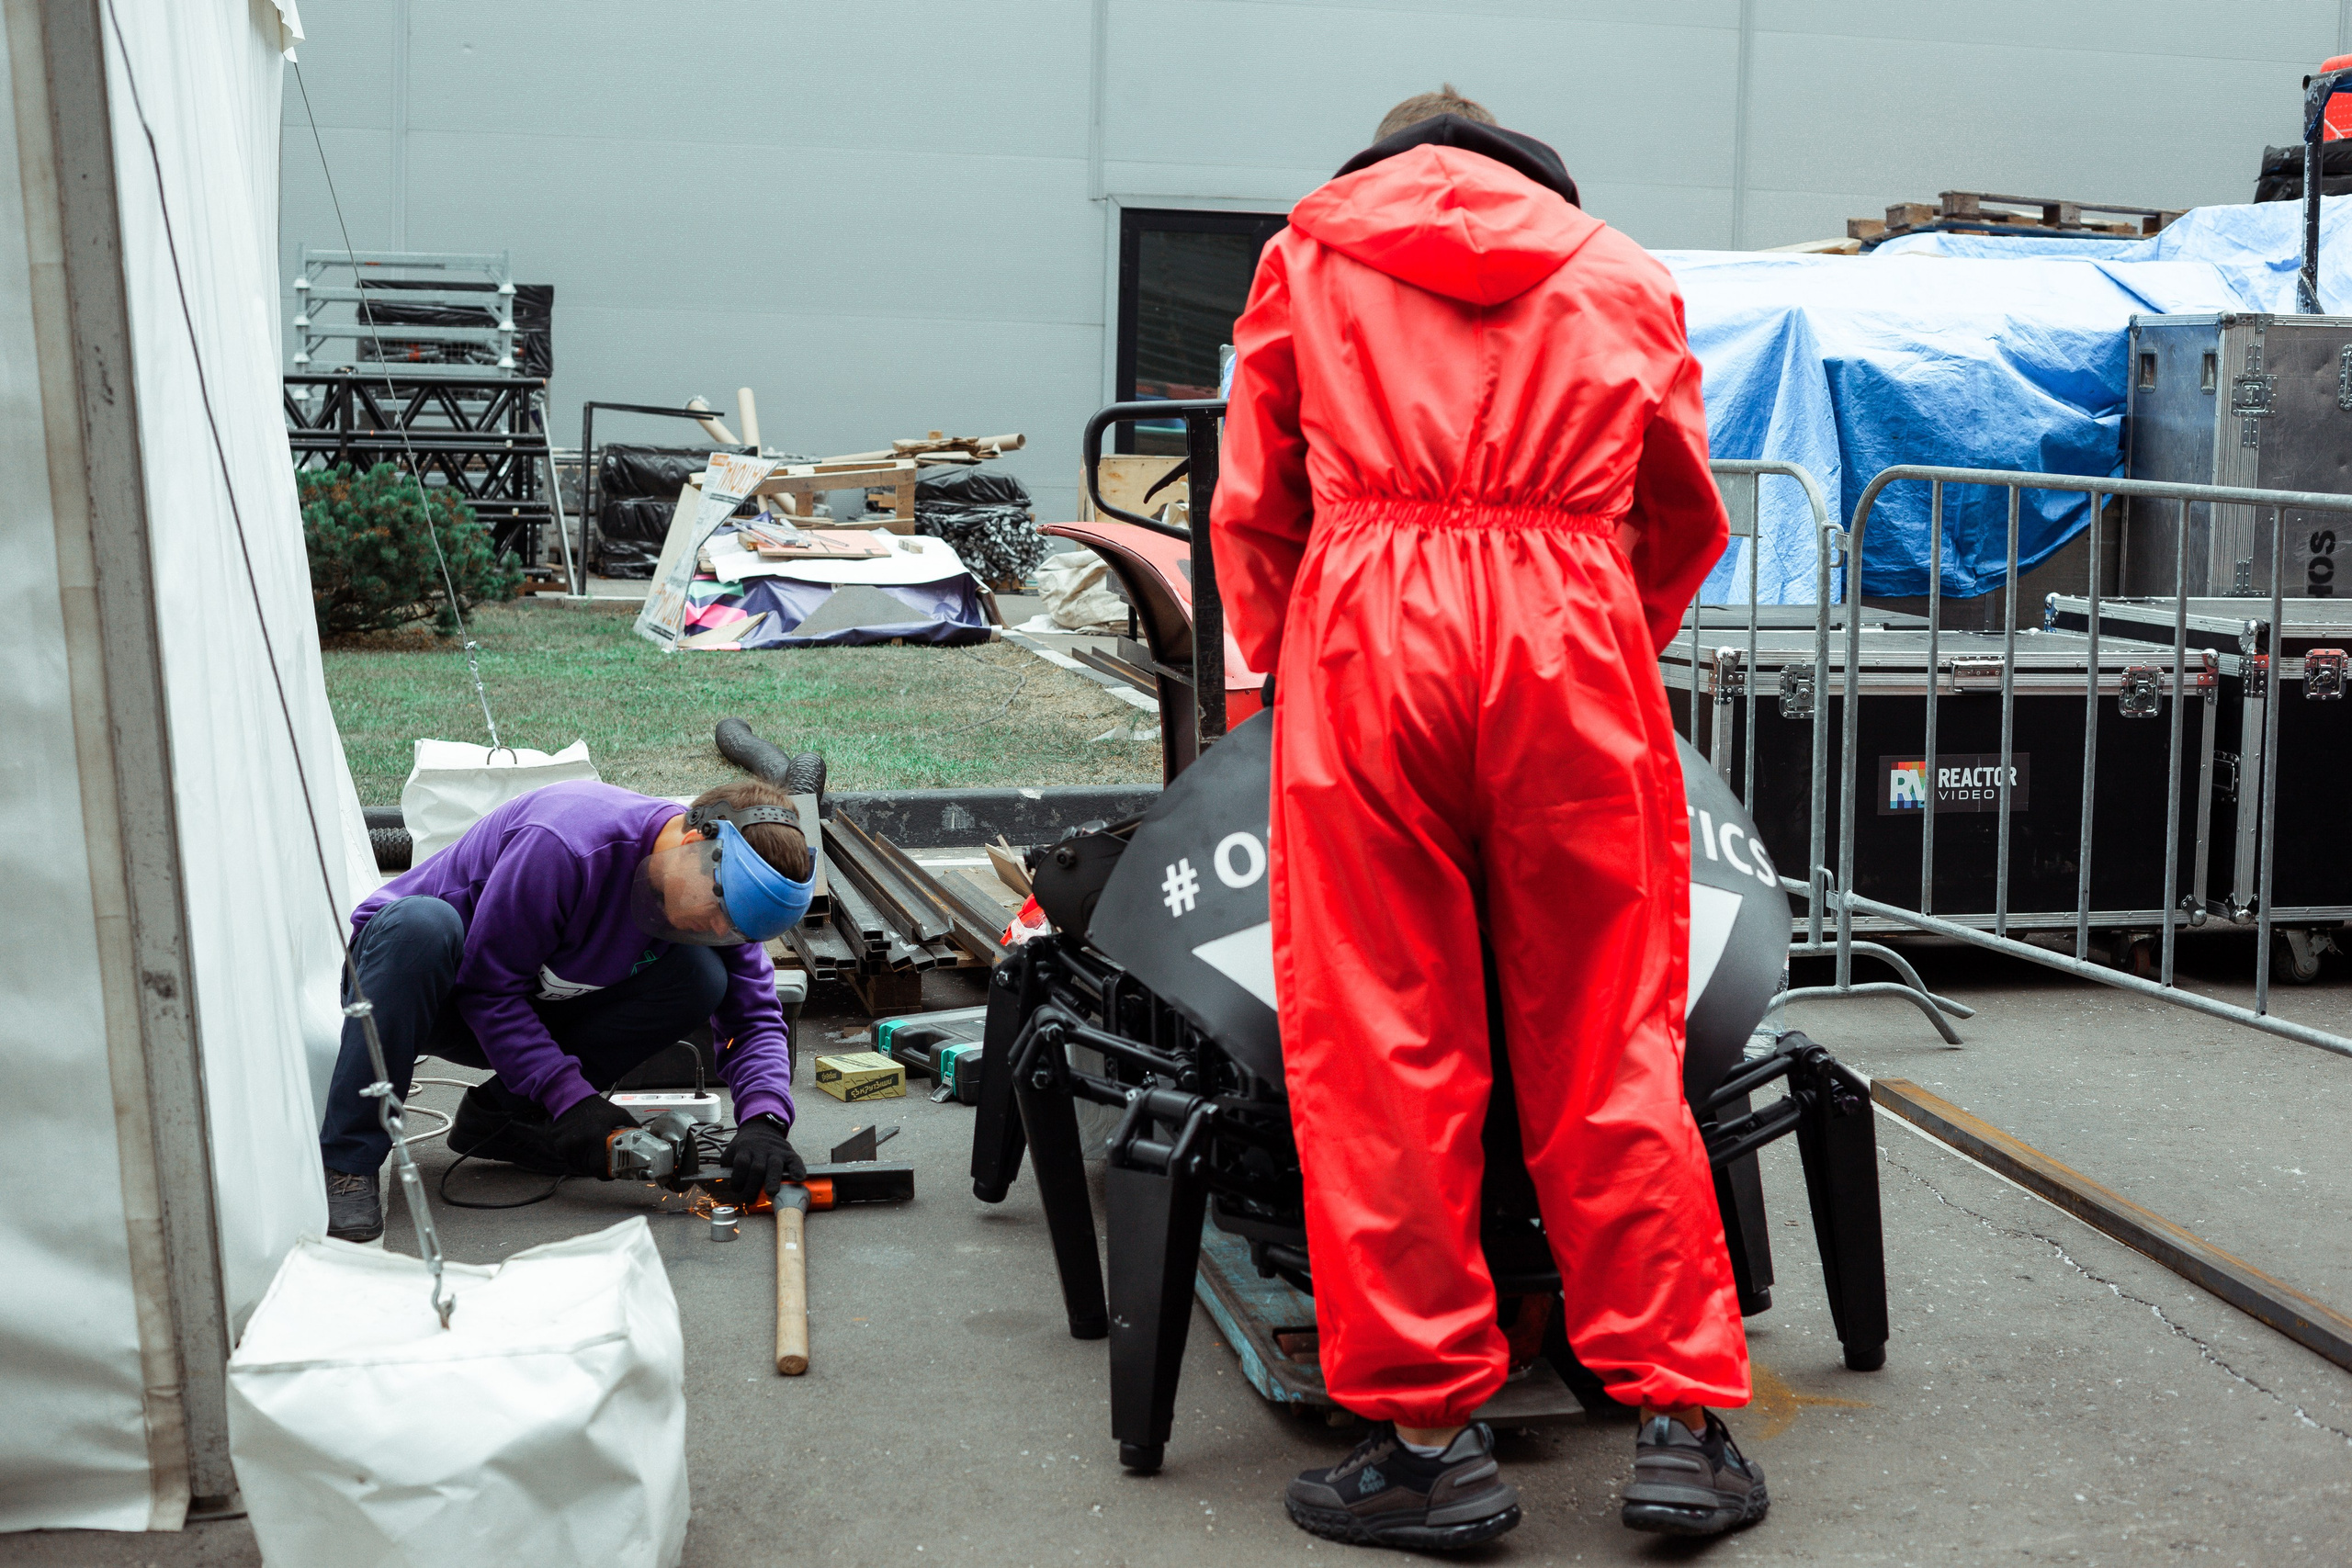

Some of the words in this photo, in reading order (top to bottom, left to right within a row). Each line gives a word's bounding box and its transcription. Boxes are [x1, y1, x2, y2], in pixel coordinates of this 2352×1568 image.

[1939, 766, 2018, 788] REACTOR
[1939, 789, 1995, 800] VIDEO
[1687, 805, 1777, 887] ICS
